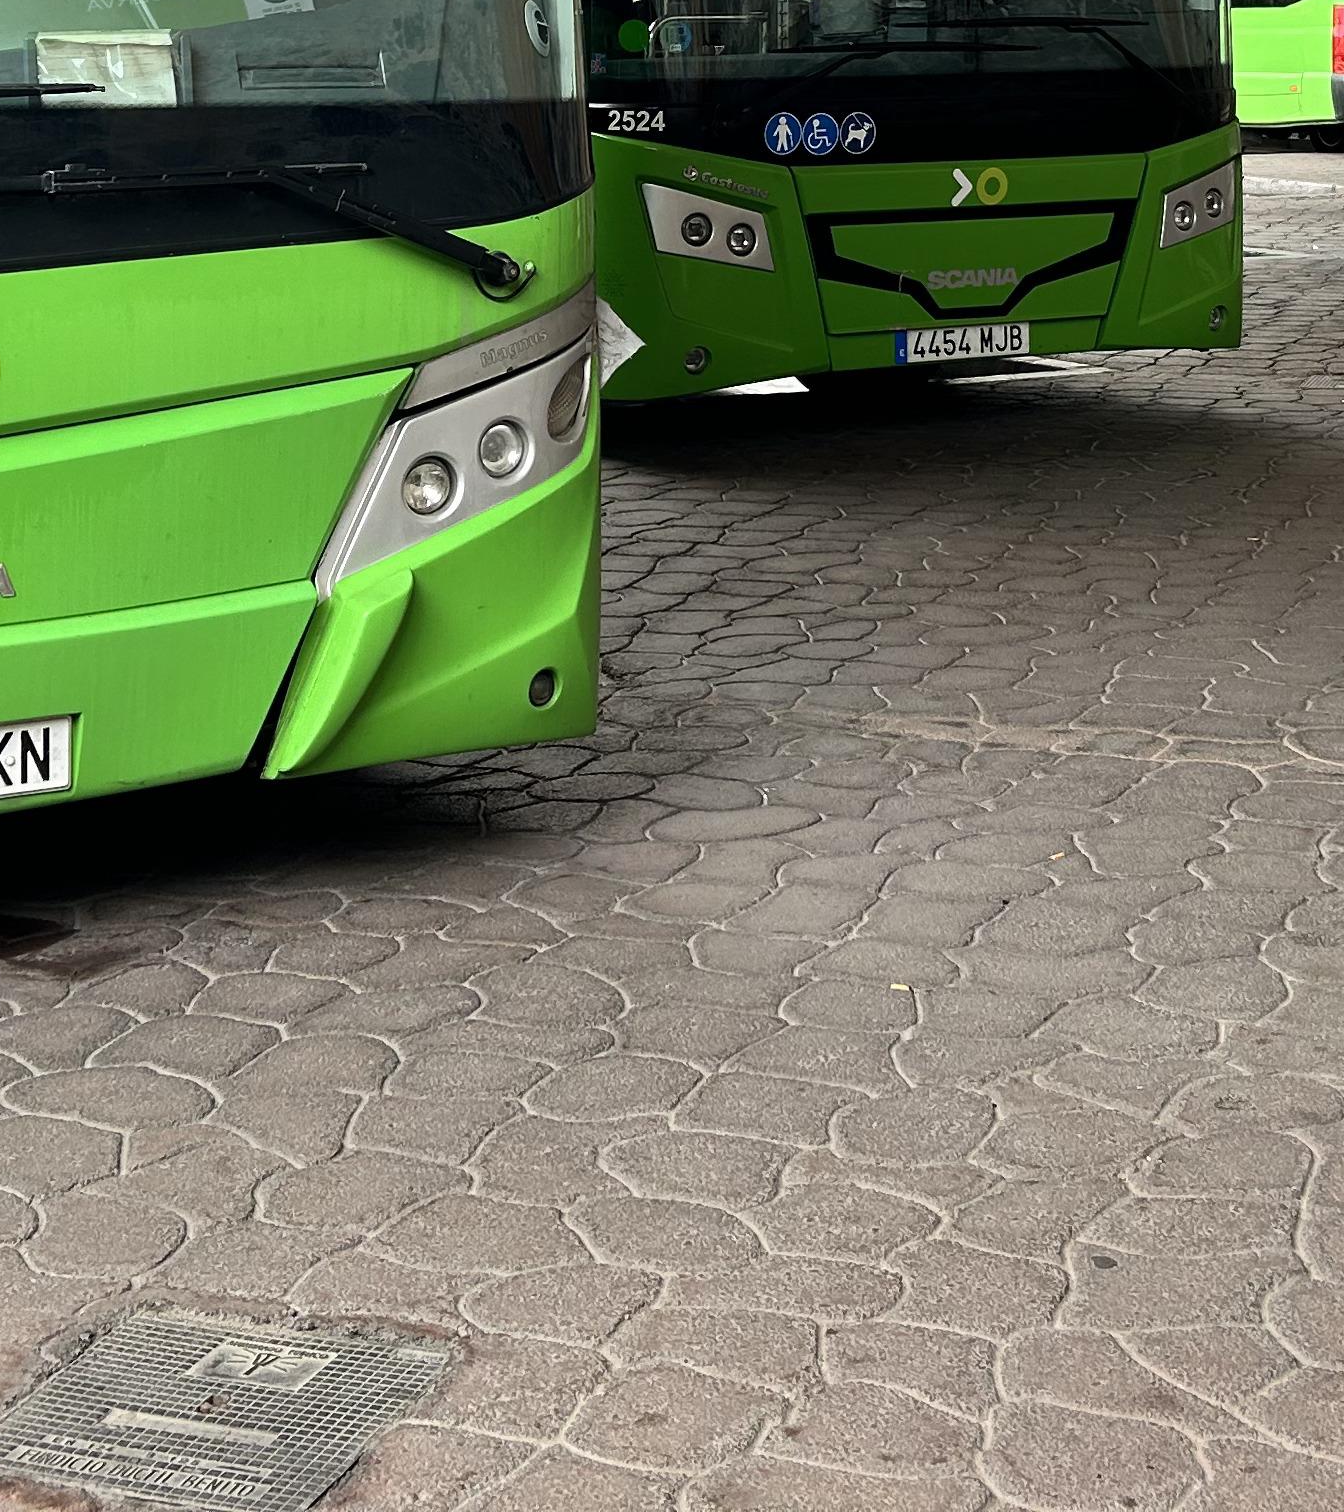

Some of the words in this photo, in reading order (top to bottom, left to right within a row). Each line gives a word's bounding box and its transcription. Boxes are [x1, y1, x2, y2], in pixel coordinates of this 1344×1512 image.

[607, 110, 666, 132] 2524
[927, 267, 1018, 290] SCANIA
[913, 328, 972, 358] 4454
[980, 325, 1023, 354] MJB
[181, 1474, 257, 1498] BENITO
